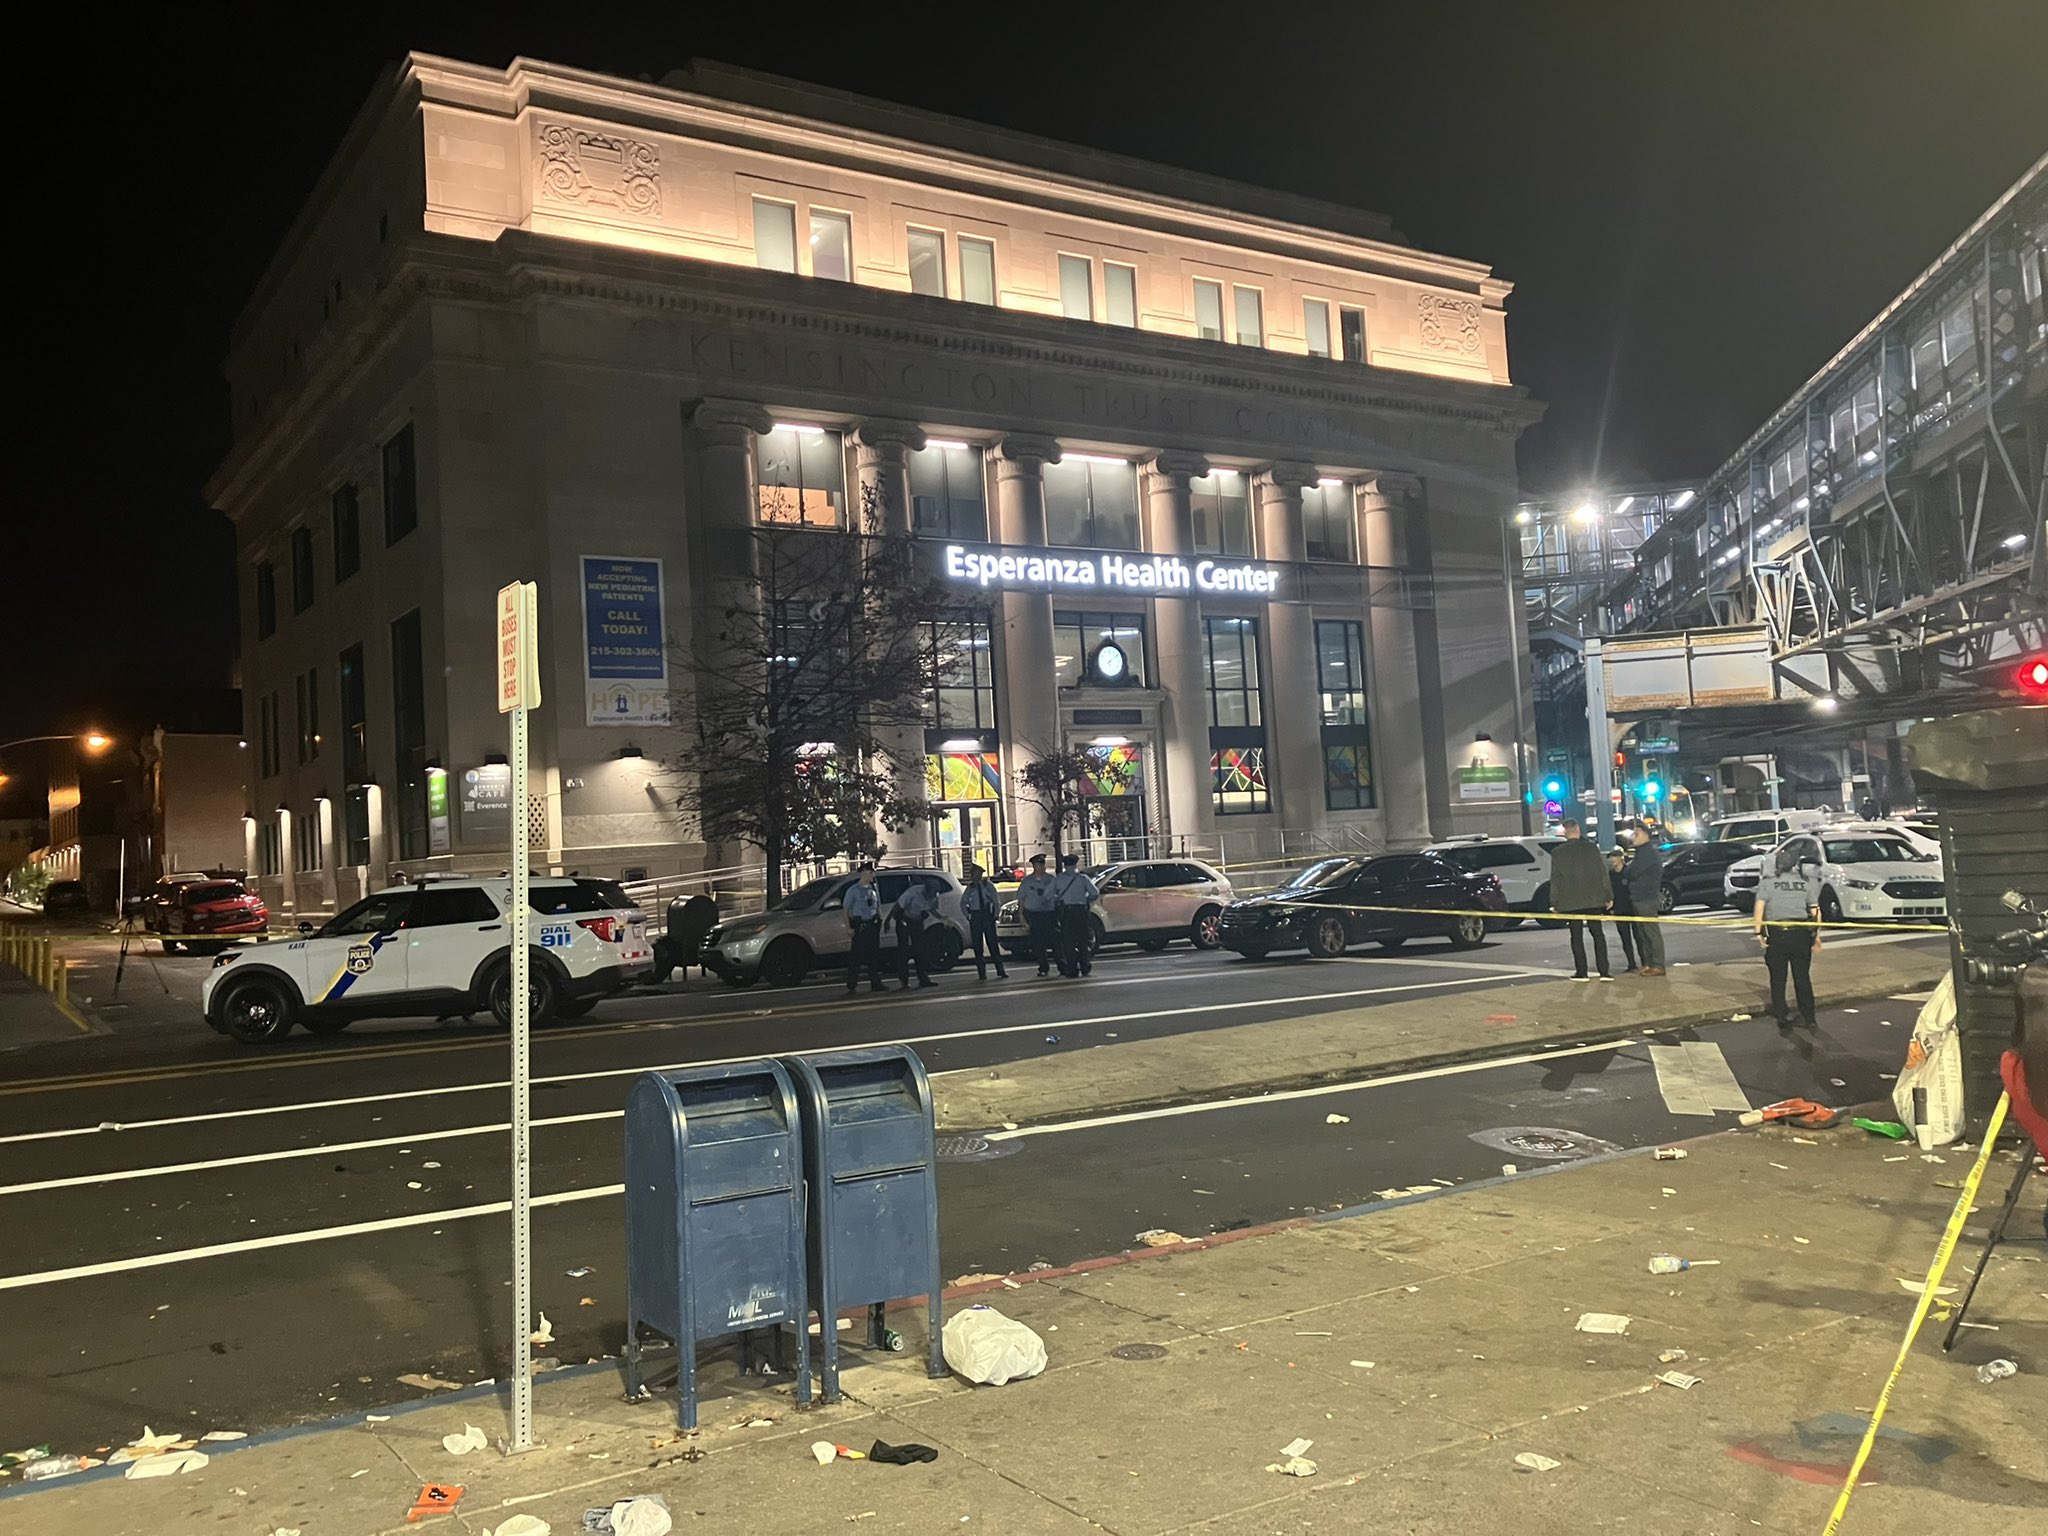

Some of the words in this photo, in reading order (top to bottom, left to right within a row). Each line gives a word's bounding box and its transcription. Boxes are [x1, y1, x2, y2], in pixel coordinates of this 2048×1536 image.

[689, 334, 1033, 403] KENSINGTON
[1073, 385, 1201, 426] TRUST
[611, 565, 633, 573] NOW
[945, 544, 1096, 586] Esperanza
[1101, 556, 1189, 588] Health
[1195, 560, 1280, 591] Center
[597, 574, 648, 583] ACCEPTING
[611, 584, 657, 592] PEDIATRIC
[602, 593, 645, 601] PATIENTS
[505, 594, 514, 613] ALL
[607, 610, 641, 621] CALL
[502, 614, 517, 637] BUSES
[601, 624, 648, 635] TODAY!
[503, 635, 516, 658] MUST
[503, 657, 516, 680] STOP
[503, 679, 516, 700] HERE
[477, 802, 508, 810] Everence
[1774, 881, 1807, 892] POLICE
[540, 925, 572, 935] DIAL
[540, 933, 573, 947] 911
[350, 950, 370, 960] POLICE
[728, 1300, 763, 1320] MIL
